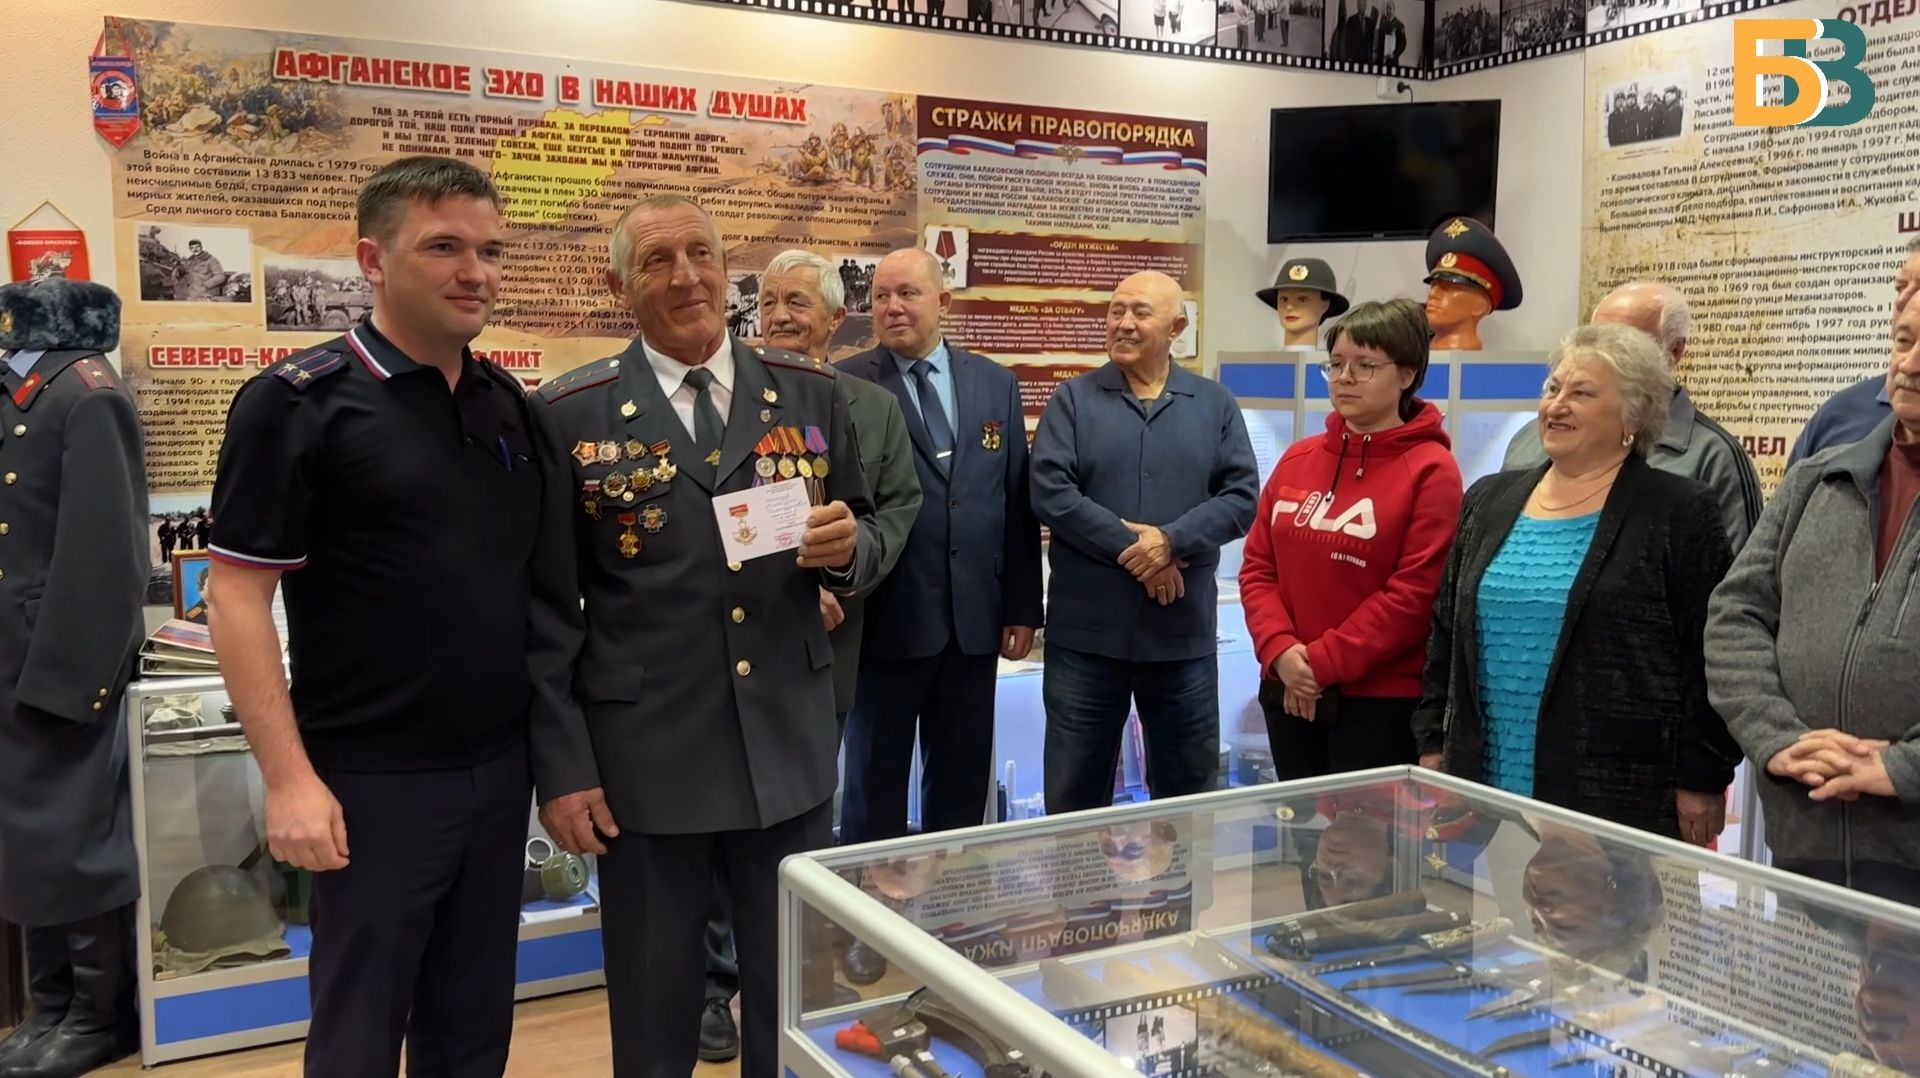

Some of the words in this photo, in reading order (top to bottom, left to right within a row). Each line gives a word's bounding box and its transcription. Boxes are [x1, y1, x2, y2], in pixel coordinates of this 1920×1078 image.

[274, 48, 472, 92] АФГАНСКОЕ
[487, 68, 544, 98] ЭХО
[560, 76, 580, 101] В
[596, 79, 698, 112] НАШИХ
[710, 90, 808, 122] ДУШАХ
[372, 106, 392, 116] ТАМ
[413, 109, 443, 120] РЕКОЙ
[448, 112, 470, 122] ЕСТЬ
[475, 114, 512, 126] ГОРНЫЙ
[518, 118, 560, 130] ПЕРЕВАЛ.
[580, 123, 631, 136] ПЕРЕВАЛОМ
[643, 128, 690, 141] СЕРПАНТИН
[694, 132, 729, 144] ДОРОГИ.
[931, 106, 1023, 132] СТРАЖИ
[1030, 113, 1196, 148] ПРАВОПОРЯДКА
[350, 116, 394, 128] ДОРОГОЙ
[399, 119, 420, 131] ТОЙ,
[424, 122, 446, 132] НАШ
[451, 124, 476, 134] ПОЛК
[480, 126, 517, 138] ВХОДИЛ
[531, 130, 565, 142] АФГАН,
[569, 133, 598, 145] КОГДА
[602, 136, 622, 146] БЫЛ
[626, 138, 656, 149] НОЧЬЮ
[660, 141, 691, 152] ПОДНЯТ
[711, 145, 747, 156] ТРЕВОГЕ.
[1703, 128, 1760, 144] Сотрудники
[1712, 144, 1745, 156] начала
[1748, 138, 1791, 151] 1980-ых
[1809, 129, 1837, 142] 1994
[1838, 128, 1863, 138] года
[1865, 123, 1898, 134] отдел
[417, 133, 450, 145] ТОГДА,
[454, 136, 496, 147] ЗЕЛЕНЫЕ
[501, 139, 539, 152] СОВСЕМ,
[567, 144, 606, 156] БЕЗУСЫЕ
[620, 148, 657, 159] ПОГОНАХ
[143, 150, 180, 161] Война
[193, 152, 267, 165] Афганистане
[270, 159, 315, 168] длилась
[329, 160, 358, 170] 1979
[399, 143, 451, 156] ПОНИМАЛИ
[455, 148, 475, 157] ДЛЯ
[511, 152, 542, 162] ЗАЧЕМ
[545, 154, 588, 166] ЗАХОДИМ
[627, 160, 682, 172] ТЕРРИТОРИЮ
[686, 164, 721, 175] АФГАНА.
[1611, 168, 1661, 182] Коновалова
[1663, 163, 1698, 175] Татьяна
[1767, 148, 1794, 161] 1996
[1821, 141, 1858, 153] январь
[1862, 134, 1891, 148] 1997
[126, 163, 151, 172] этой
[156, 164, 190, 174] войне
[193, 167, 251, 177] составили
[272, 169, 296, 179] 833
[299, 173, 347, 182] человек.
[1641, 178, 1690, 191] составляла
[1763, 158, 1839, 176] Формирование
[1851, 148, 1920, 164] сотрудников
[1785, 172, 1844, 186] законности
[1853, 163, 1915, 179] служебных
[126, 178, 212, 188] неисчислимые
[215, 180, 248, 192] беды,
[251, 184, 309, 194] страдания
[495, 170, 553, 183] Афганистан
[555, 176, 592, 186] прошло
[594, 177, 623, 187] более
[626, 181, 691, 192] полумиллиона
[692, 185, 736, 195] советских
[766, 188, 796, 199] Общие
[855, 196, 884, 206] страны
[578, 187, 598, 197] 330
[1705, 197, 1746, 209] подбора,
[1748, 188, 1831, 204] комплектования
[1841, 180, 1903, 194] воспитания
[127, 191, 172, 201] мирных
[175, 193, 229, 204] жителей,
[231, 196, 303, 205] оказавшихся
[306, 199, 328, 208] под
[542, 199, 581, 208] погибло
[701, 196, 726, 207] ребят
[728, 199, 773, 210] вернулись
[146, 203, 183, 215] Среди
[185, 207, 231, 216] личного
[234, 209, 278, 218] состава
[281, 209, 351, 221] Балаковской
[715, 210, 744, 219] солдат
[805, 215, 872, 228] оппозиционеров
[1621, 218, 1674, 231] пенсионеры
[1779, 201, 1836, 216] Сафронова
[1864, 194, 1906, 207] Жукова
[505, 222, 550, 232] которые
[551, 224, 602, 233] выполнили
[721, 234, 743, 242] долг
[751, 235, 800, 246] республике
[1616, 263, 1650, 275] октября
[1652, 260, 1676, 271] 1918
[1725, 253, 1798, 268] сформированы
[1800, 245, 1883, 261] инструкторский
[1720, 261, 1880, 281] организационно-инспекторское
[1723, 282, 1749, 293] 1969
[1795, 279, 1830, 289] создан
[1754, 295, 1783, 306] улице
[1710, 309, 1784, 321] подразделение
[1820, 305, 1874, 314] появилось
[1697, 322, 1722, 332] 1980
[1765, 320, 1810, 332] сентябрь
[1816, 318, 1844, 329] 1997
[1742, 349, 1794, 359] руководил
[1796, 347, 1852, 356] полковник
[1752, 362, 1782, 372] группа
[1784, 360, 1880, 372] информационного
[1723, 376, 1775, 385] должность
[1711, 389, 1750, 399] органом
[1715, 399, 1751, 412] борьбы
[1742, 435, 1786, 459] ДЕЛ
[1271, 486, 1377, 540] FILA
